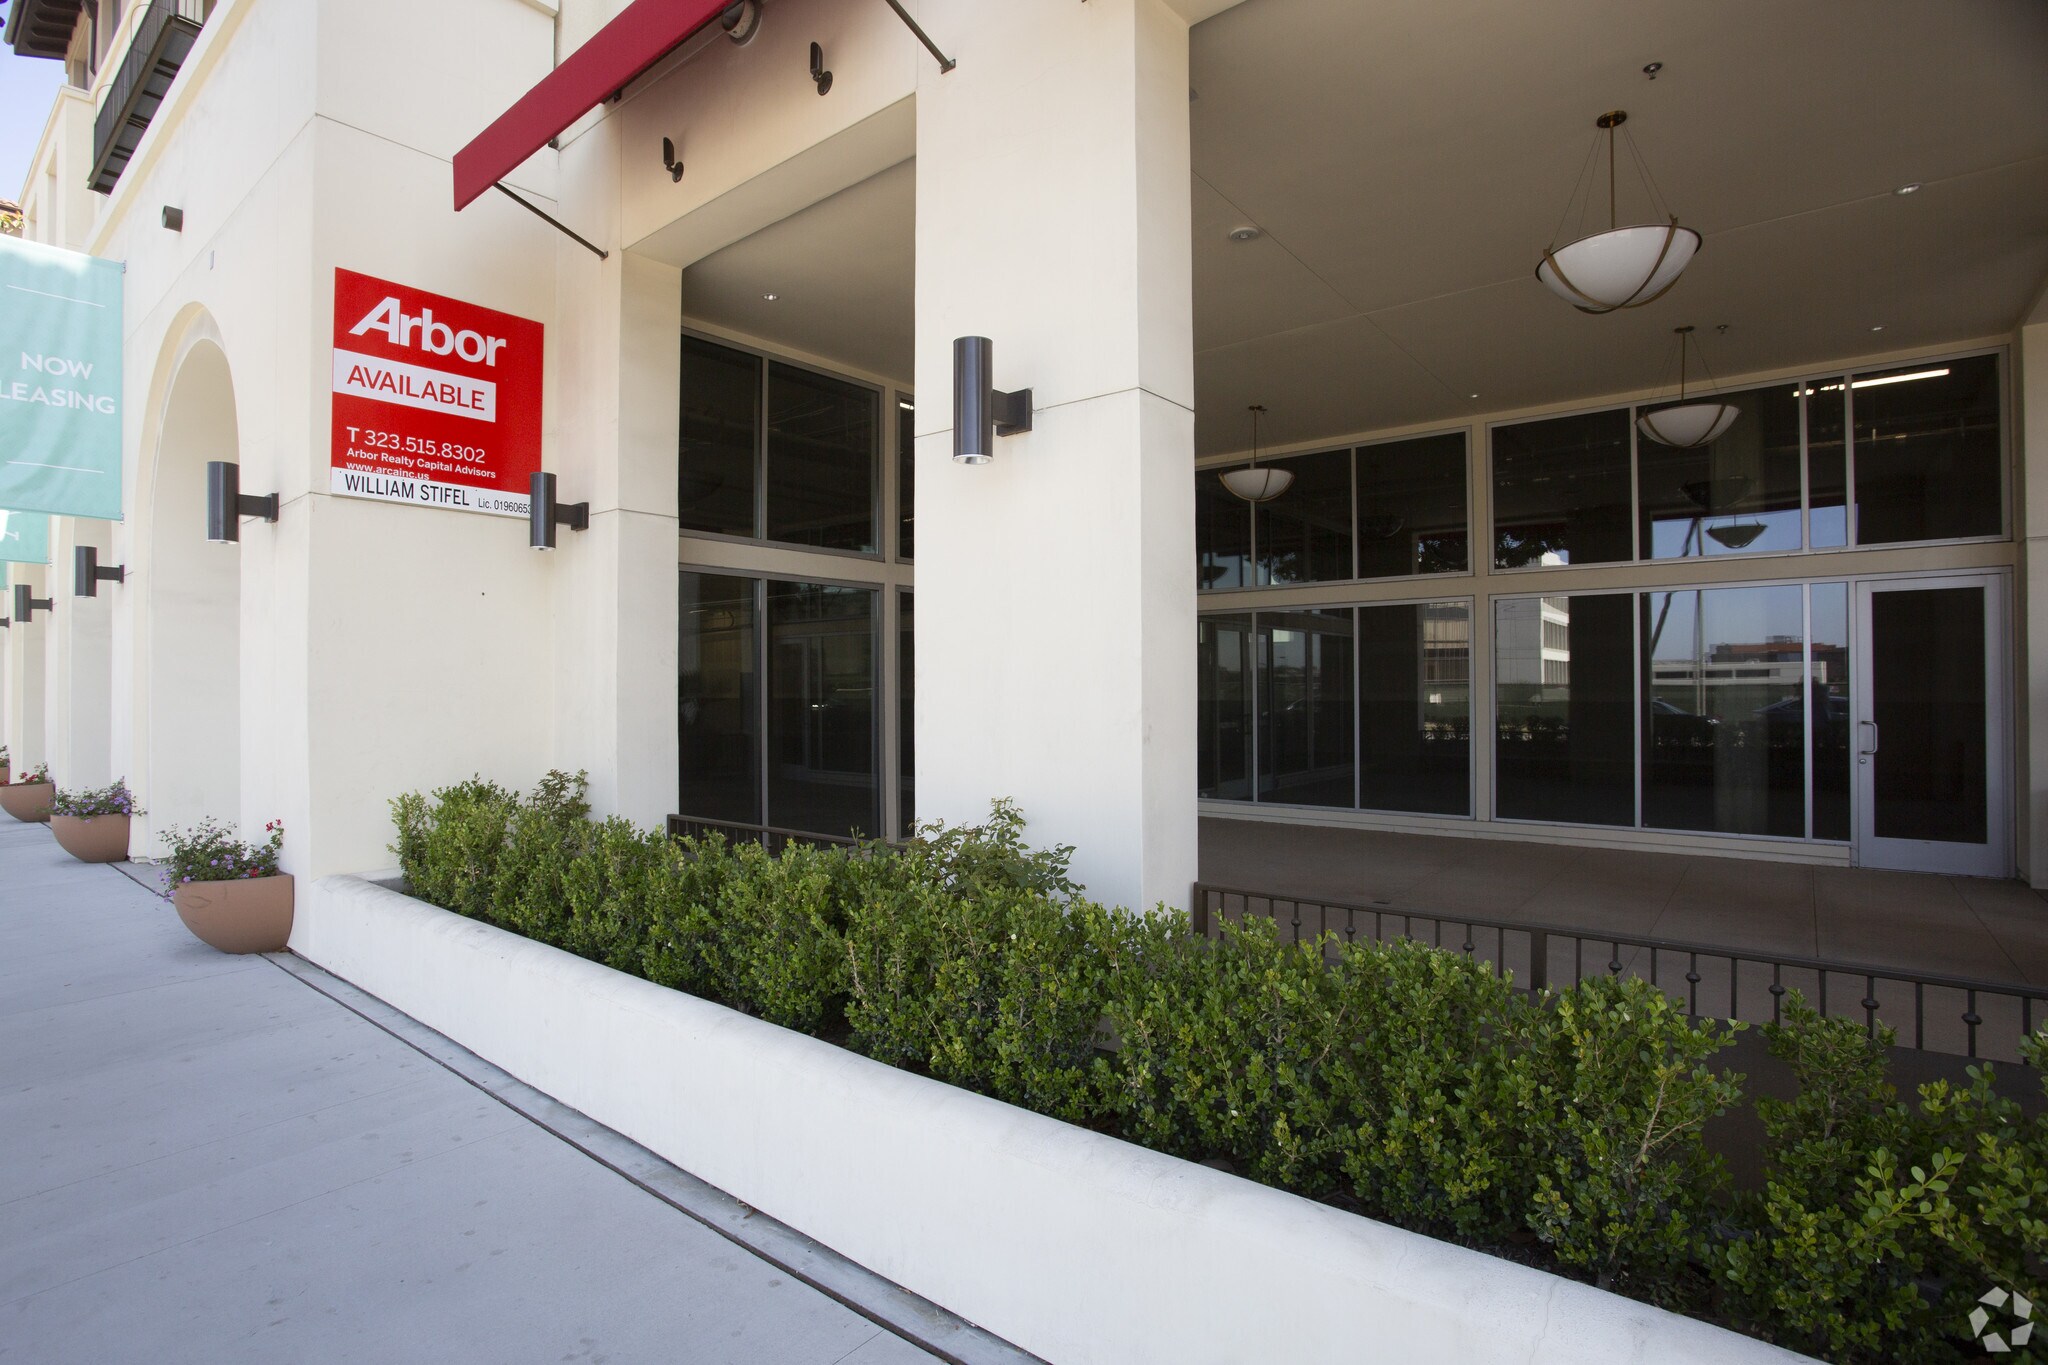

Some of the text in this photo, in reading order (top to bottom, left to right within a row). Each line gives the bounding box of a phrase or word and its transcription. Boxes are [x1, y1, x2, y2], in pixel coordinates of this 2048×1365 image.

[348, 296, 507, 367] Arbor
[21, 351, 94, 380] NOW
[0, 381, 116, 414] LEASING
[346, 364, 486, 411] AVAILABLE
[346, 426, 486, 464] T 323.515.8302
[346, 447, 497, 479] Arbor Realty Capital Advisors
[346, 462, 430, 480] www.arcainc.us
[345, 473, 415, 500] WILLIAM
[420, 484, 470, 507] STIFEL
[478, 497, 492, 509] Lic.
